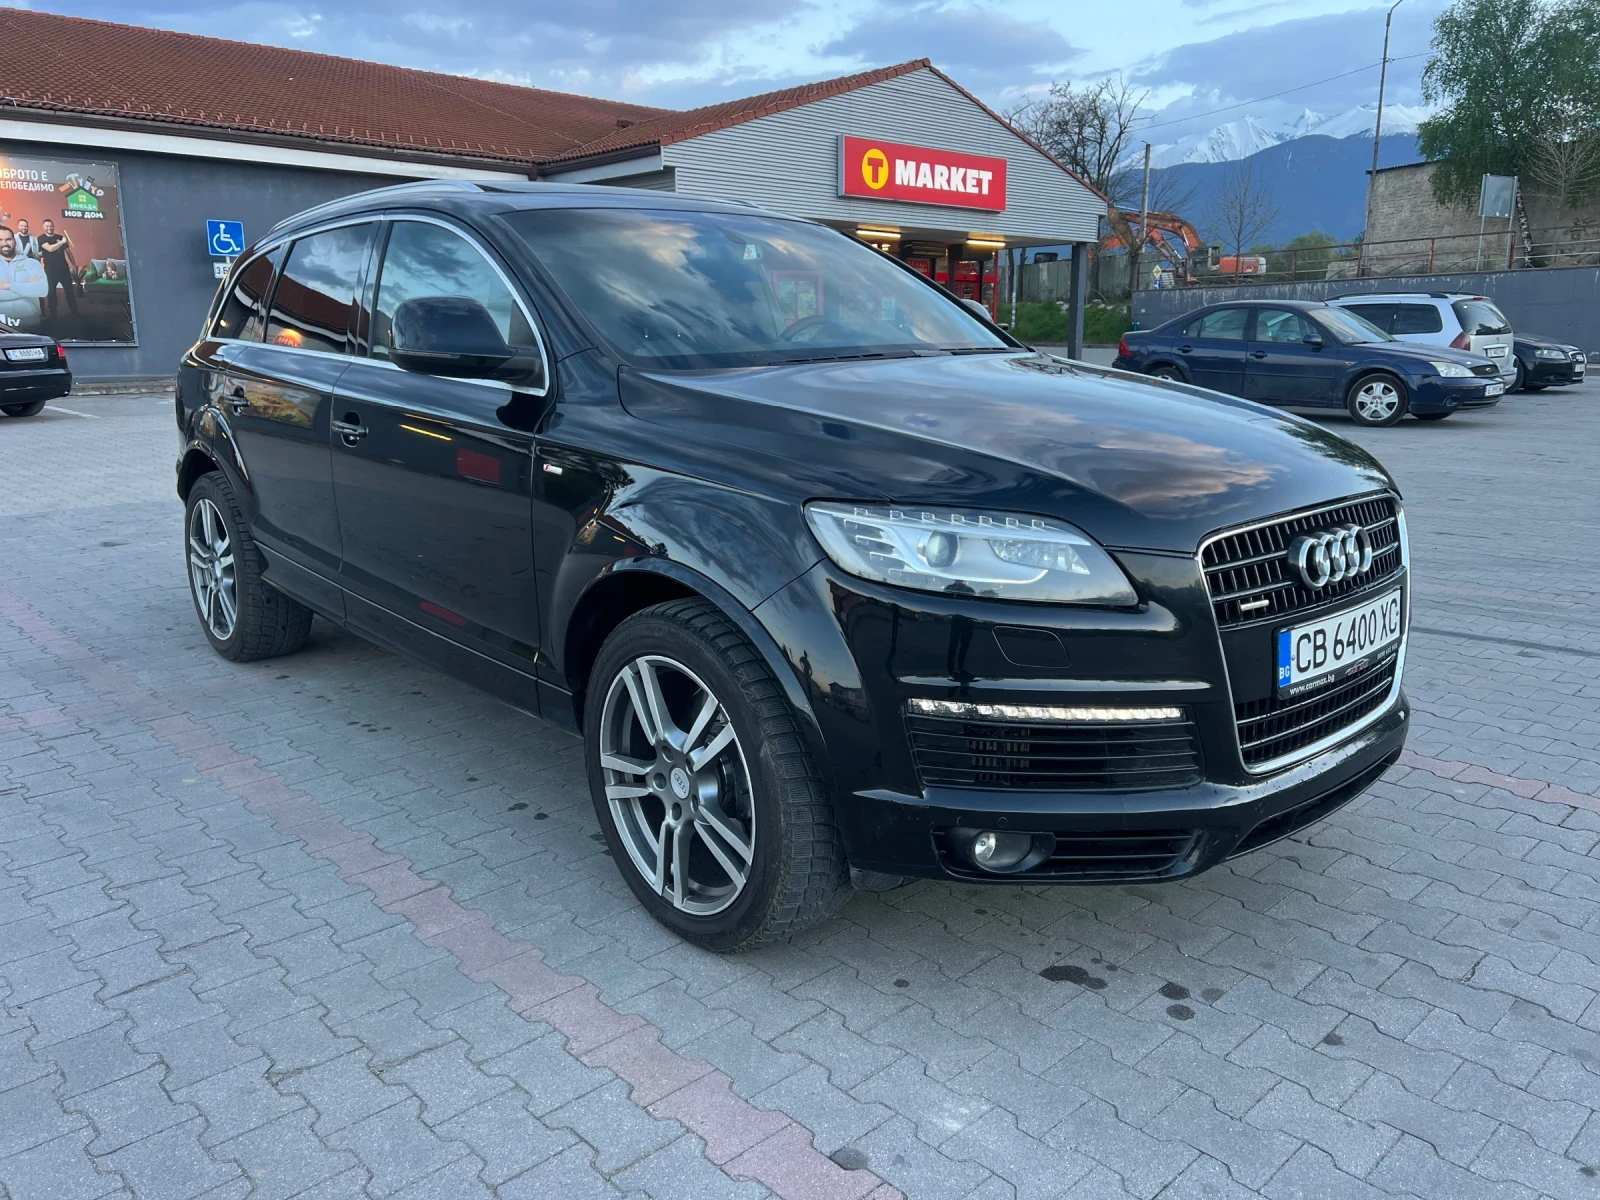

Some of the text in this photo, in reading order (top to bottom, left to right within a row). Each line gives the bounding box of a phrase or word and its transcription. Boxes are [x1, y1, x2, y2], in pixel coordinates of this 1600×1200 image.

[41, 170, 48, 181] Е
[867, 157, 993, 195] T MARKET
[0, 180, 54, 192] ЕПОБЕДИМО
[64, 210, 104, 219] НОВ ДОМ
[7, 316, 20, 327] tv
[1296, 597, 1398, 674] CB 6400 XC
[1279, 665, 1291, 680] BG
[1289, 673, 1335, 696] www.carmax.bg
